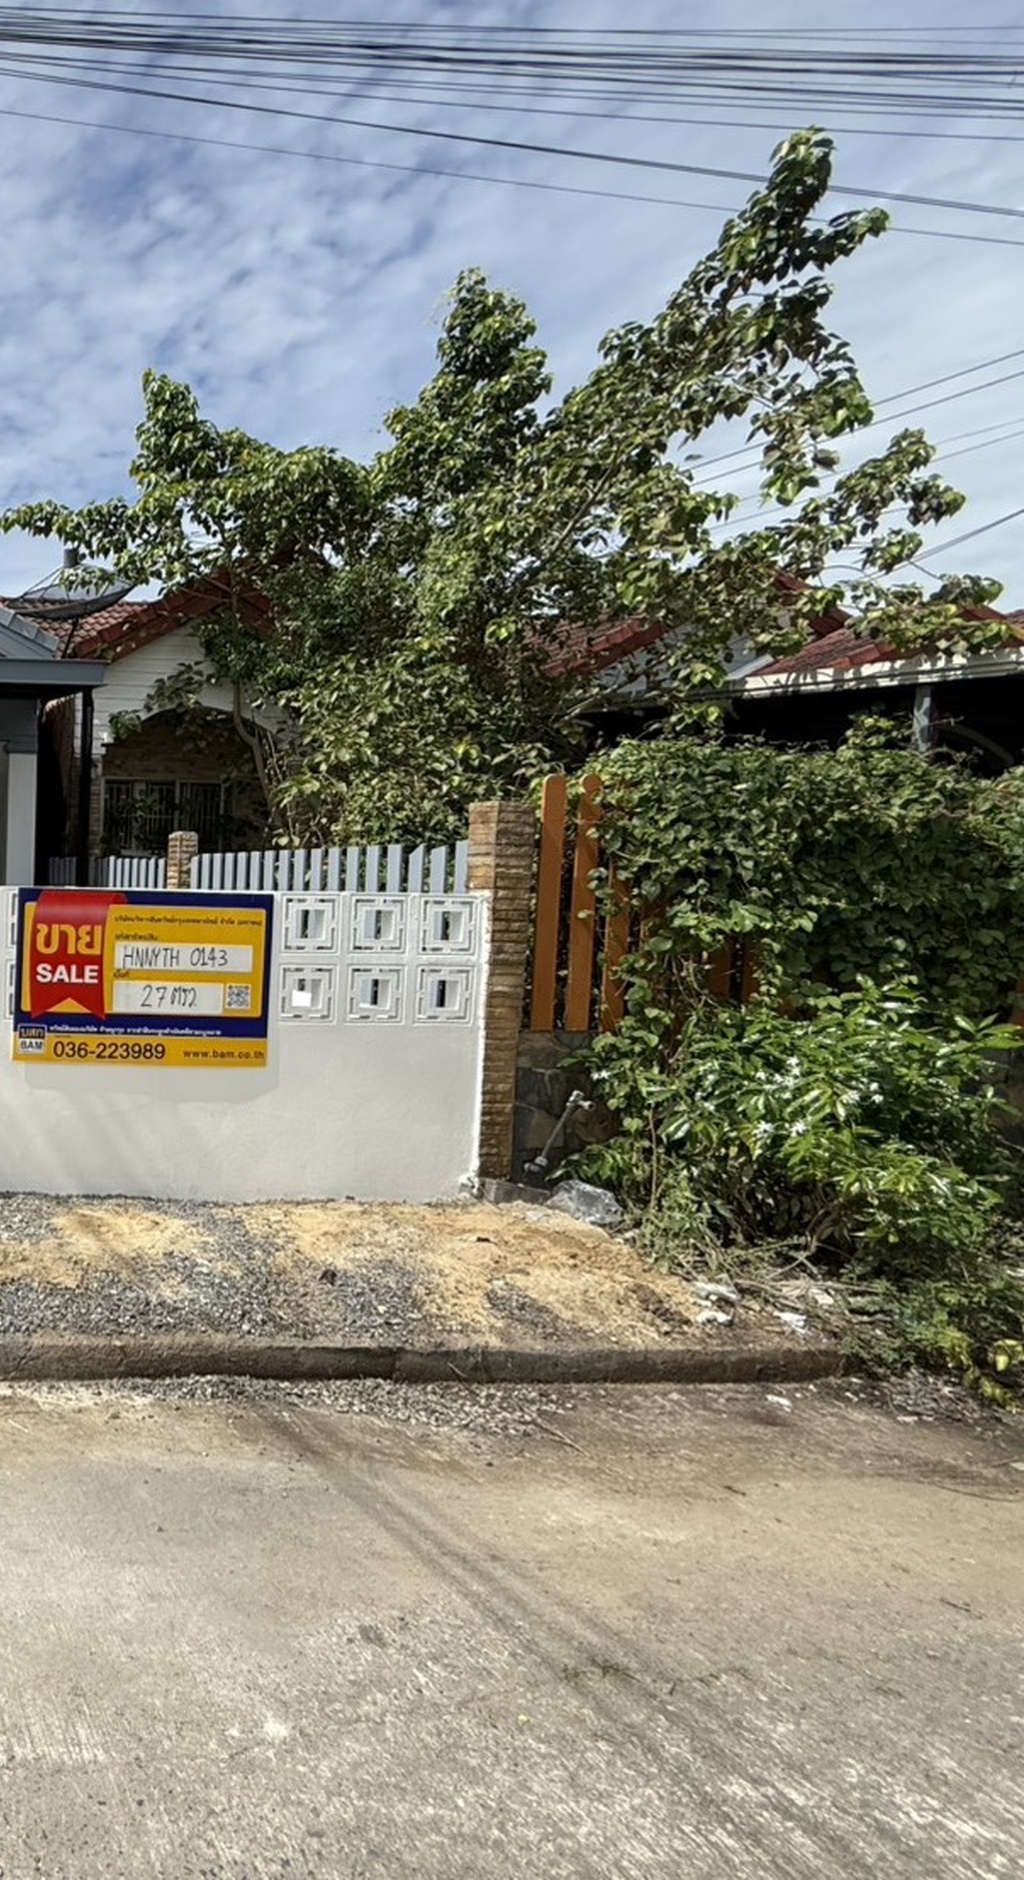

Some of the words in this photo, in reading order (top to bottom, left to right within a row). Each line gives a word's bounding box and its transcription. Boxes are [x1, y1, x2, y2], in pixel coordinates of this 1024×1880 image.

[36, 923, 102, 955] ขาย
[190, 947, 228, 967] 0143
[36, 963, 99, 984] SALE
[140, 984, 167, 1007] 27
[20, 1040, 43, 1050] BAM
[53, 1041, 166, 1060] 036-223989
[183, 1048, 265, 1060] www.bam.co.th
